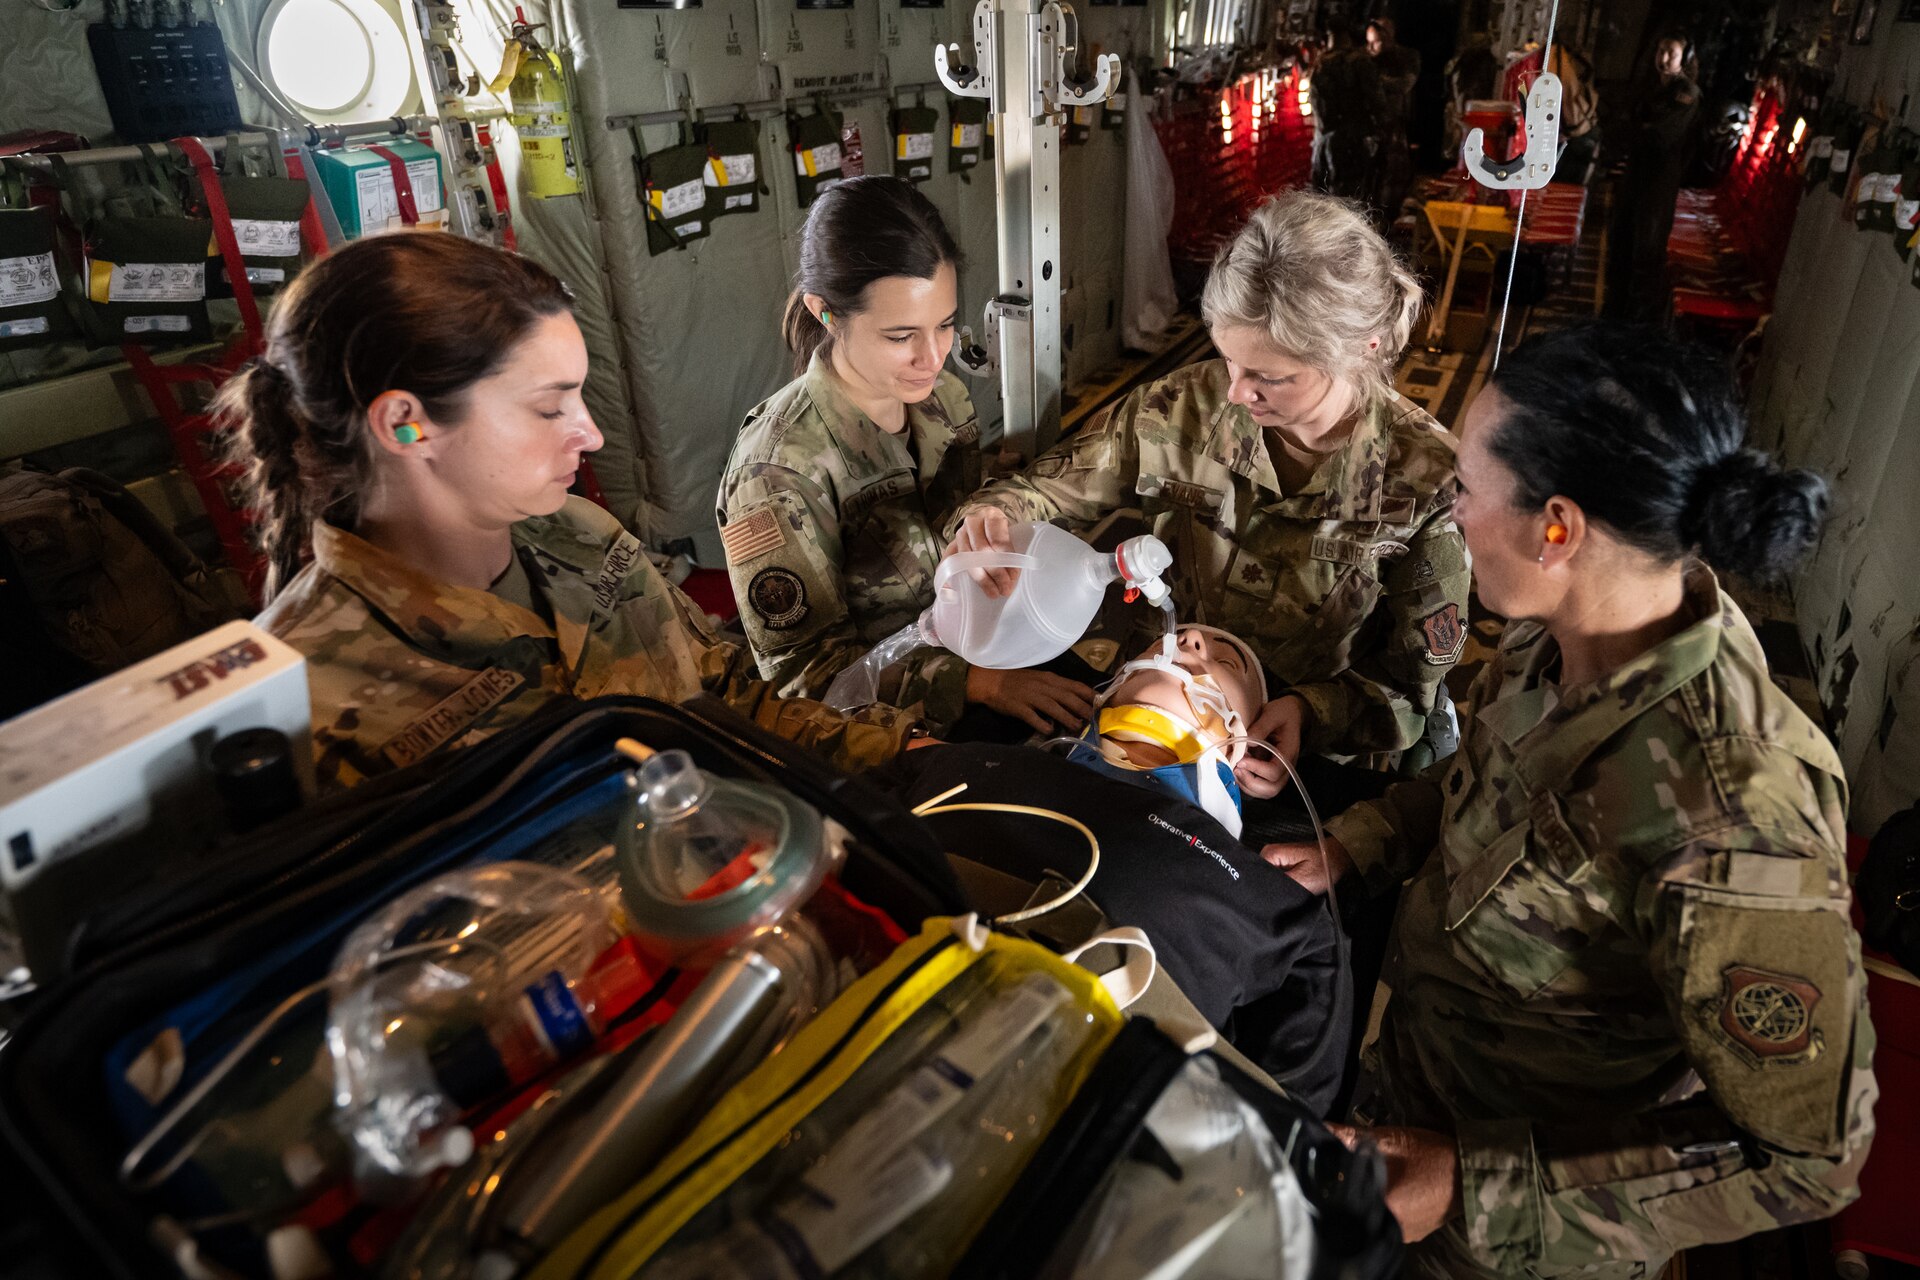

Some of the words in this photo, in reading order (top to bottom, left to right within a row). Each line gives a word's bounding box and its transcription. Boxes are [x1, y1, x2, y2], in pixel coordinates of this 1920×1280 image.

[727, 32, 738, 44] LS
[789, 30, 800, 41] LS
[604, 539, 638, 580] FORCE
[1339, 545, 1365, 567] AIR
[1148, 813, 1193, 842] Operative
[1194, 839, 1240, 880] Experience
